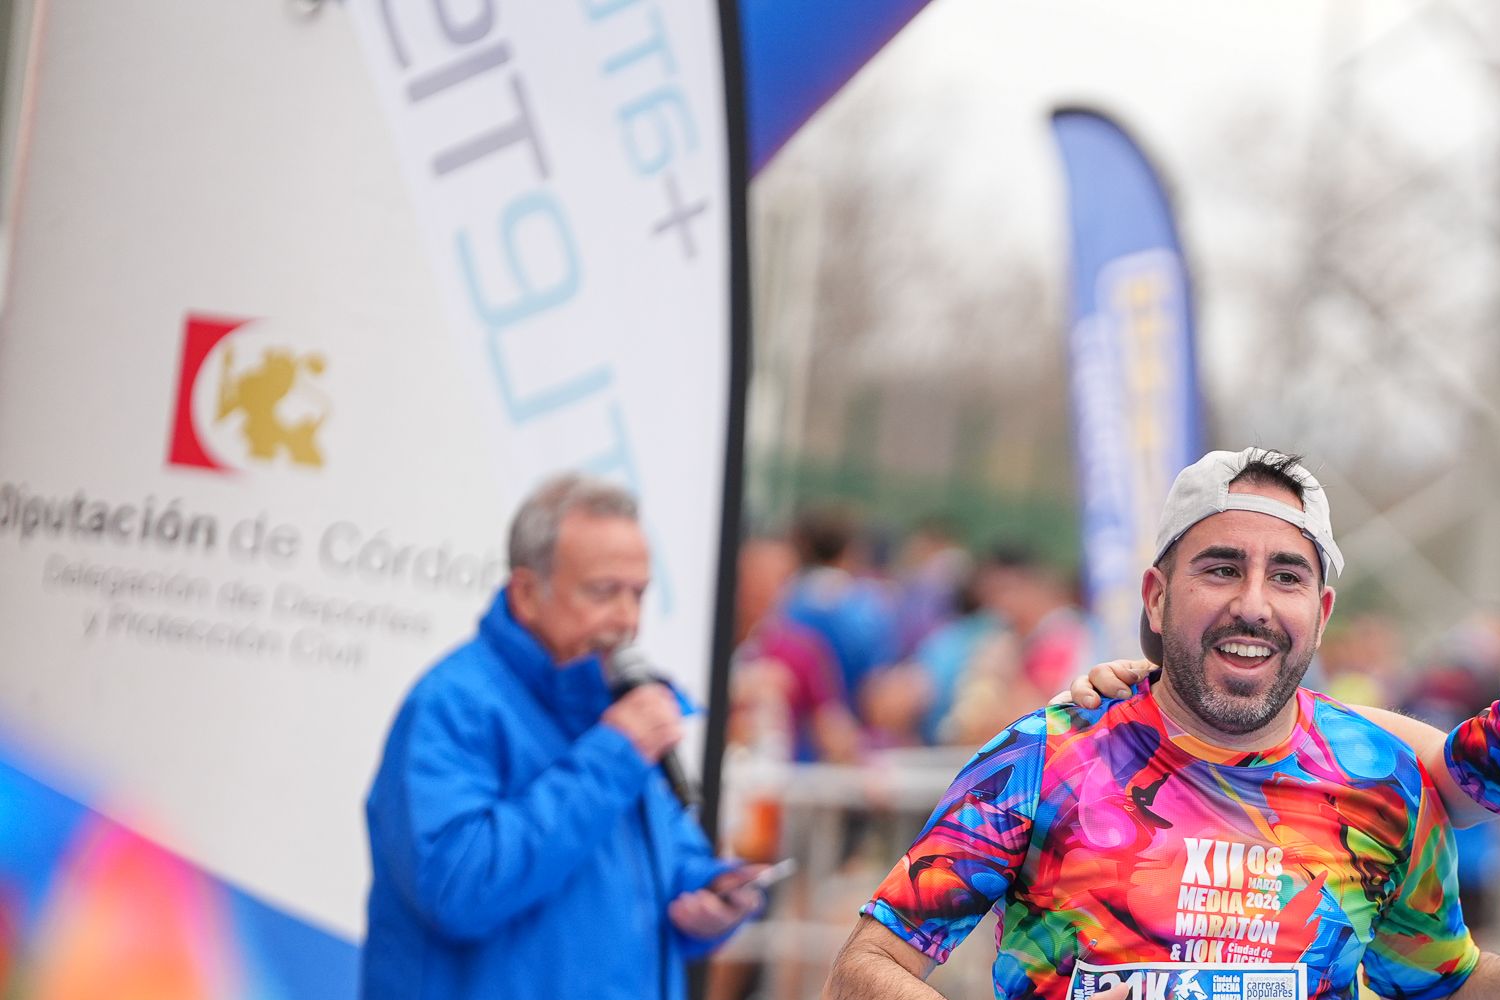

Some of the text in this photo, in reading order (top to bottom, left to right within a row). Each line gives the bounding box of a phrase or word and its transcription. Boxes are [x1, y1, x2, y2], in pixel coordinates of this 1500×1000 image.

[1181, 838, 1245, 889] XII
[1247, 845, 1283, 876] 08
[1248, 877, 1282, 891] MARZO
[1177, 885, 1245, 915] MEDIA
[1246, 892, 1280, 911] 2026
[1175, 913, 1280, 945] MARATÓN
[1170, 939, 1224, 963] & 10K
[1228, 943, 1272, 958] Ciudad de
[1213, 982, 1240, 993] LUCENA
[1247, 982, 1286, 992] carreras
[1247, 989, 1293, 1000] populares
